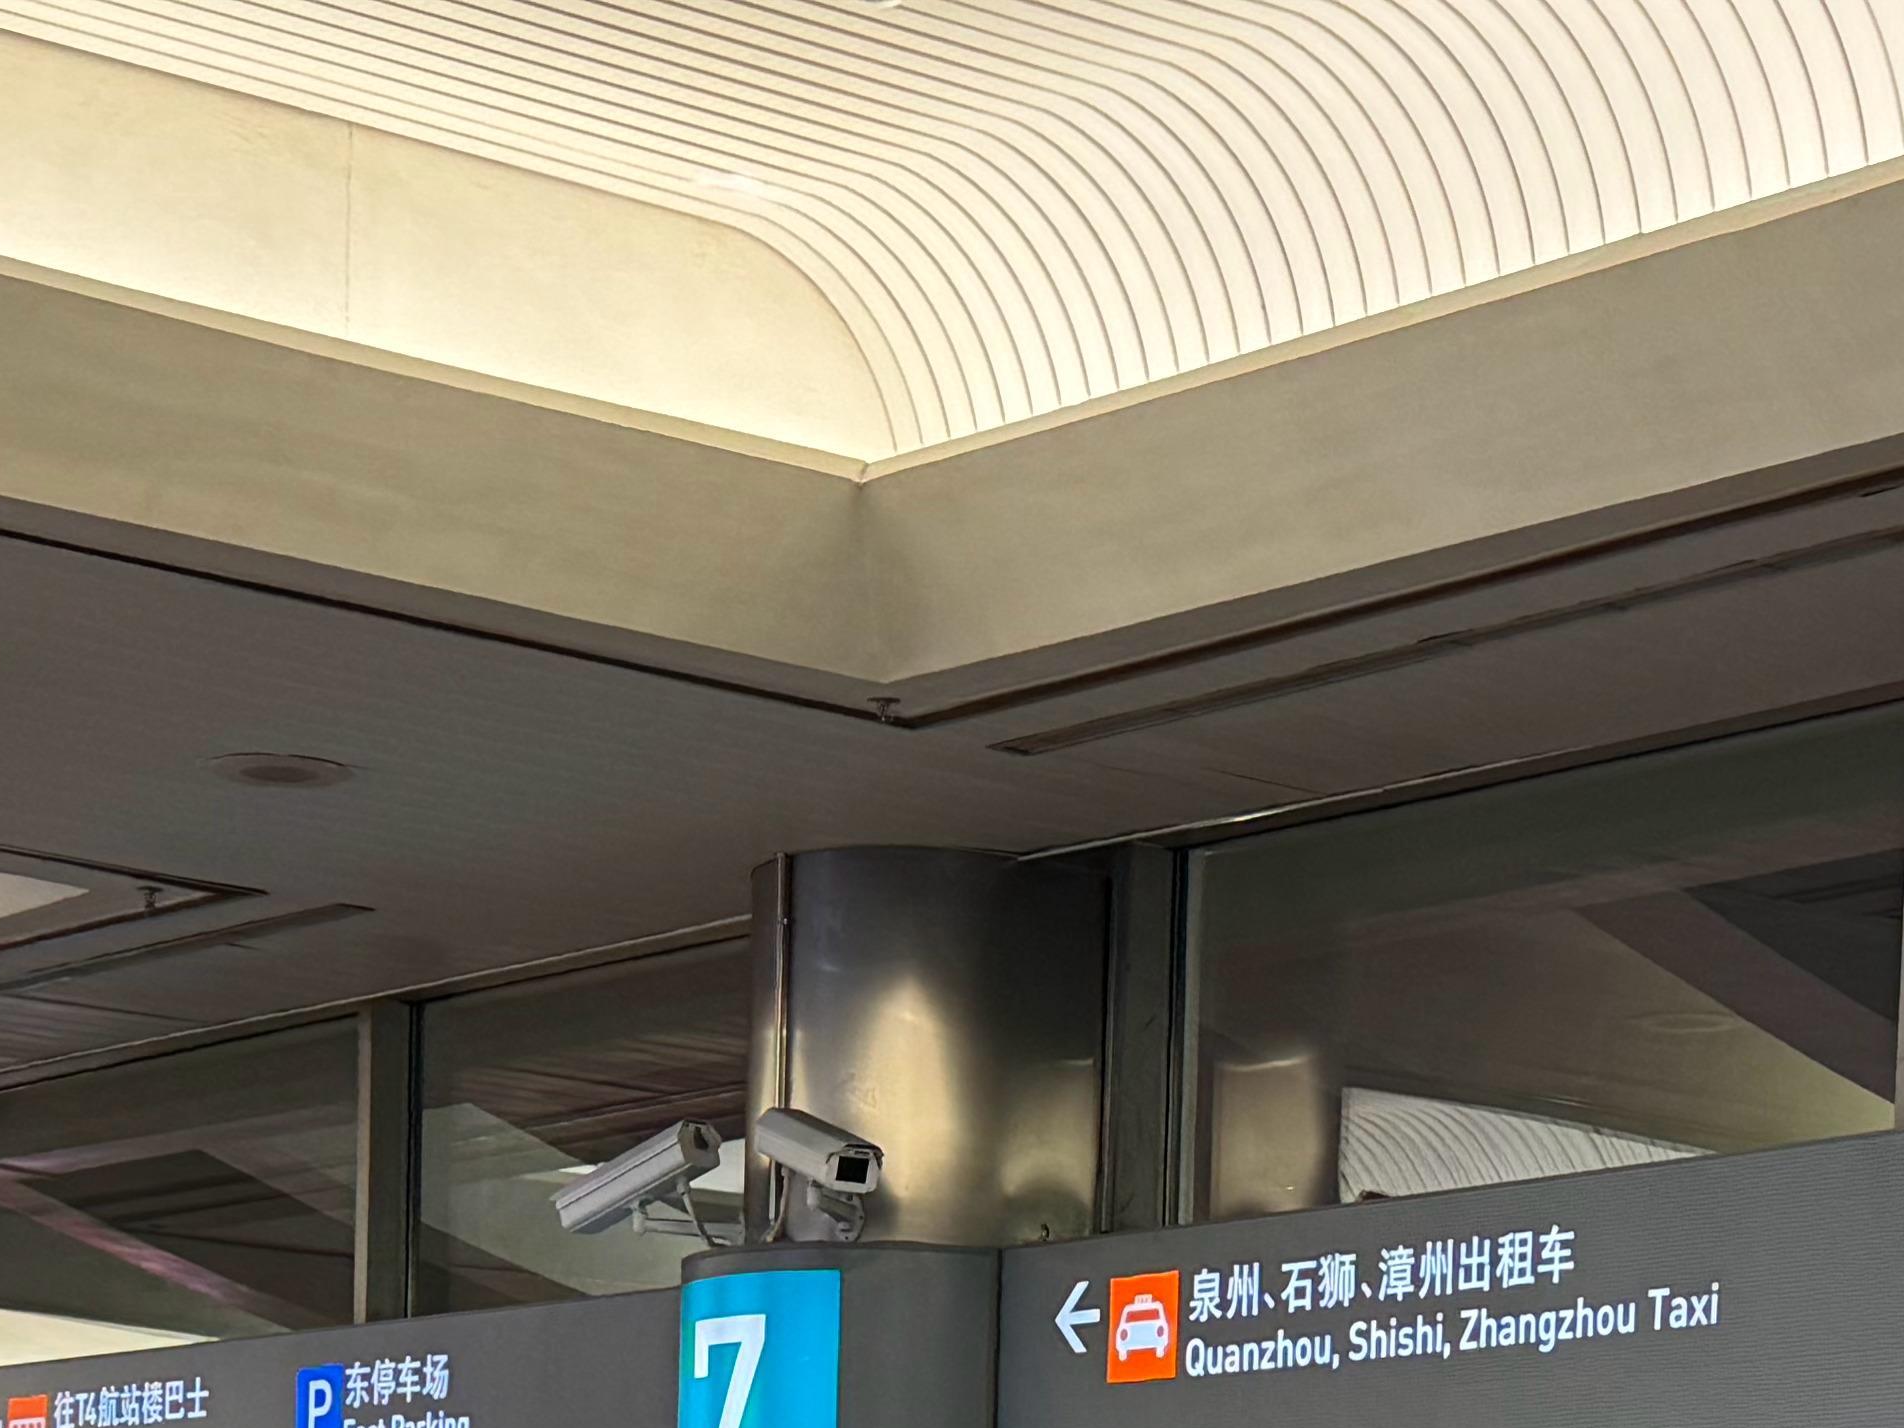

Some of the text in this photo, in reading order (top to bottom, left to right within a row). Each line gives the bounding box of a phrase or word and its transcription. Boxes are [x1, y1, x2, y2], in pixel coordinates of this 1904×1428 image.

[1189, 1225, 1575, 1322] 泉州、石狮、漳州出租车
[1185, 1282, 1720, 1378] Quanzhou, Shishi, Zhangzhou Taxi
[345, 1354, 449, 1408] 东停车场
